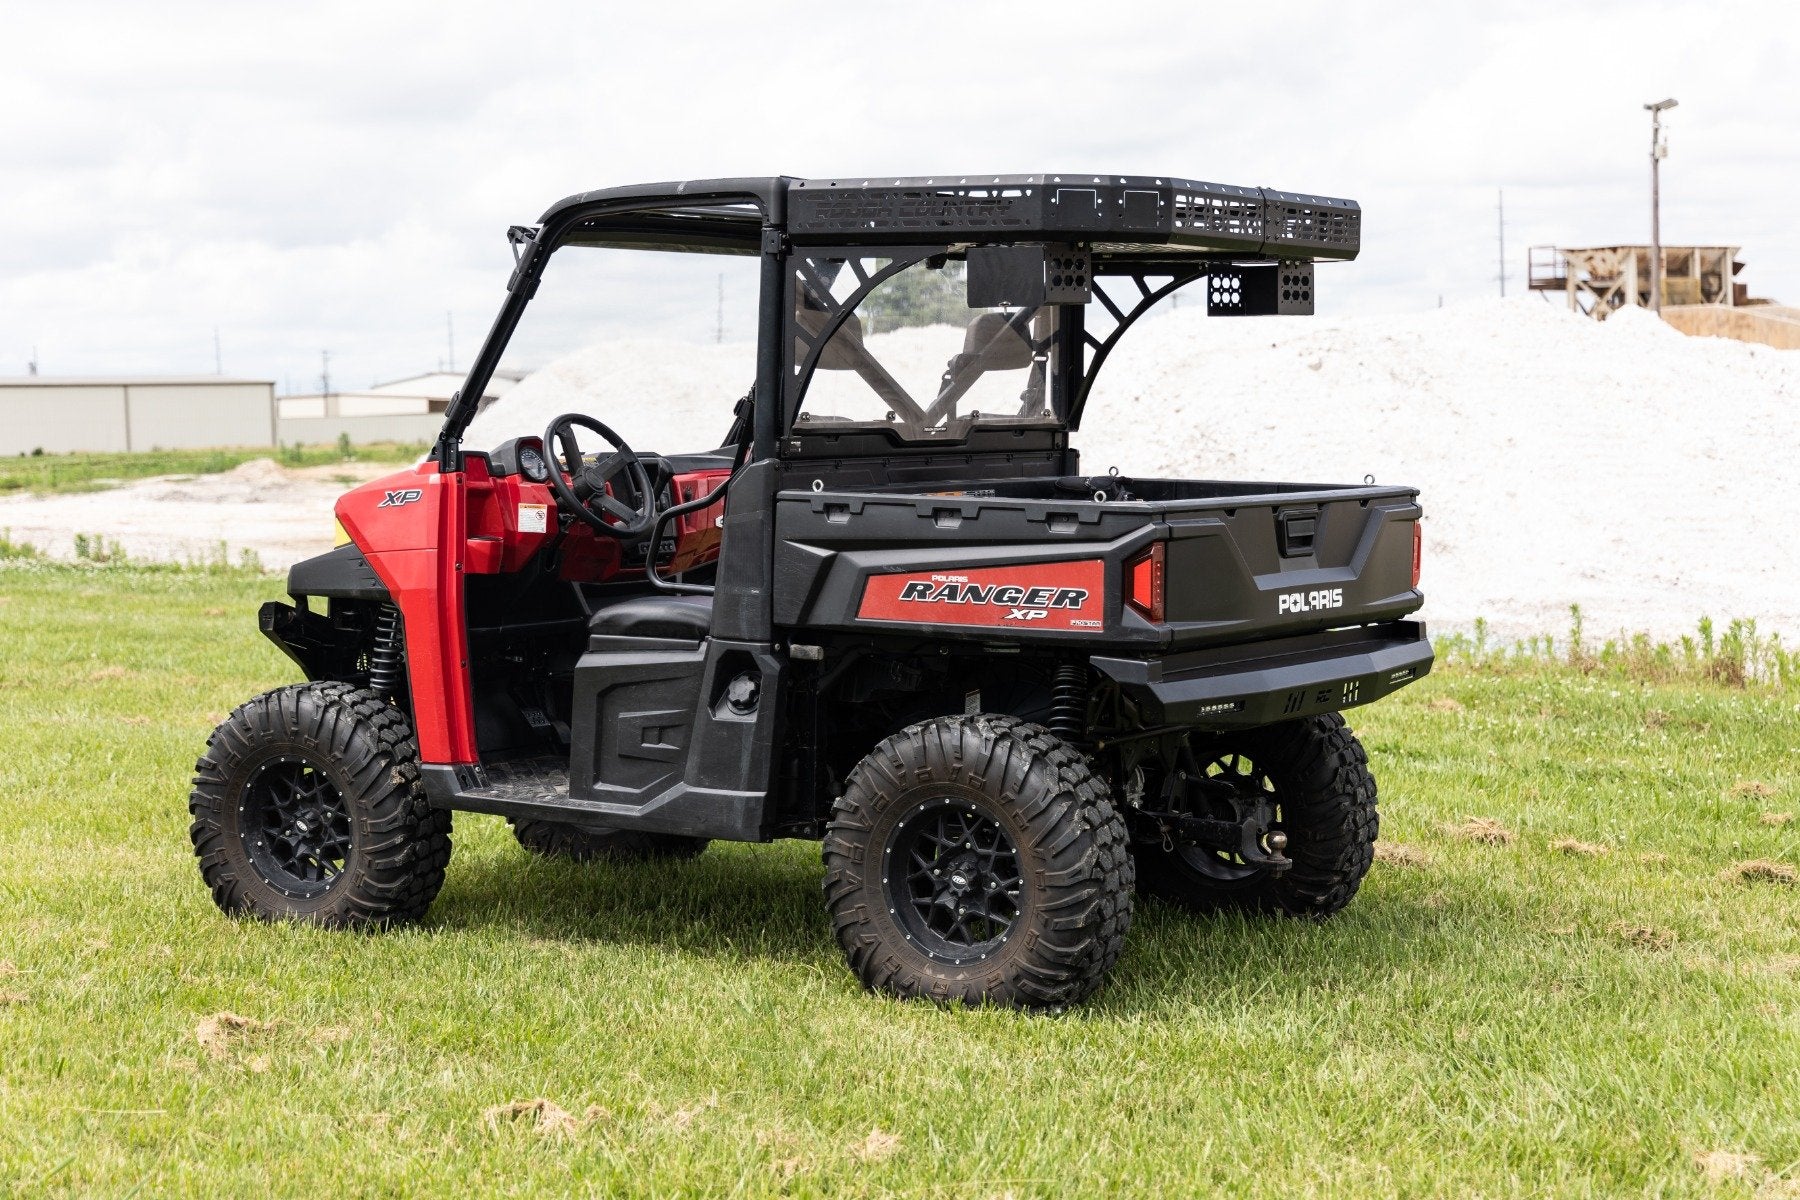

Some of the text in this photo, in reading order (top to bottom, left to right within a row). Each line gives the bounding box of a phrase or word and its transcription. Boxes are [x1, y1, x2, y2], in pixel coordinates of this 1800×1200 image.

[377, 489, 422, 507] XP
[931, 575, 968, 583] POLARIS
[899, 581, 1089, 609] RANGER
[1278, 588, 1343, 615] POLARIS
[1004, 608, 1048, 620] XP
